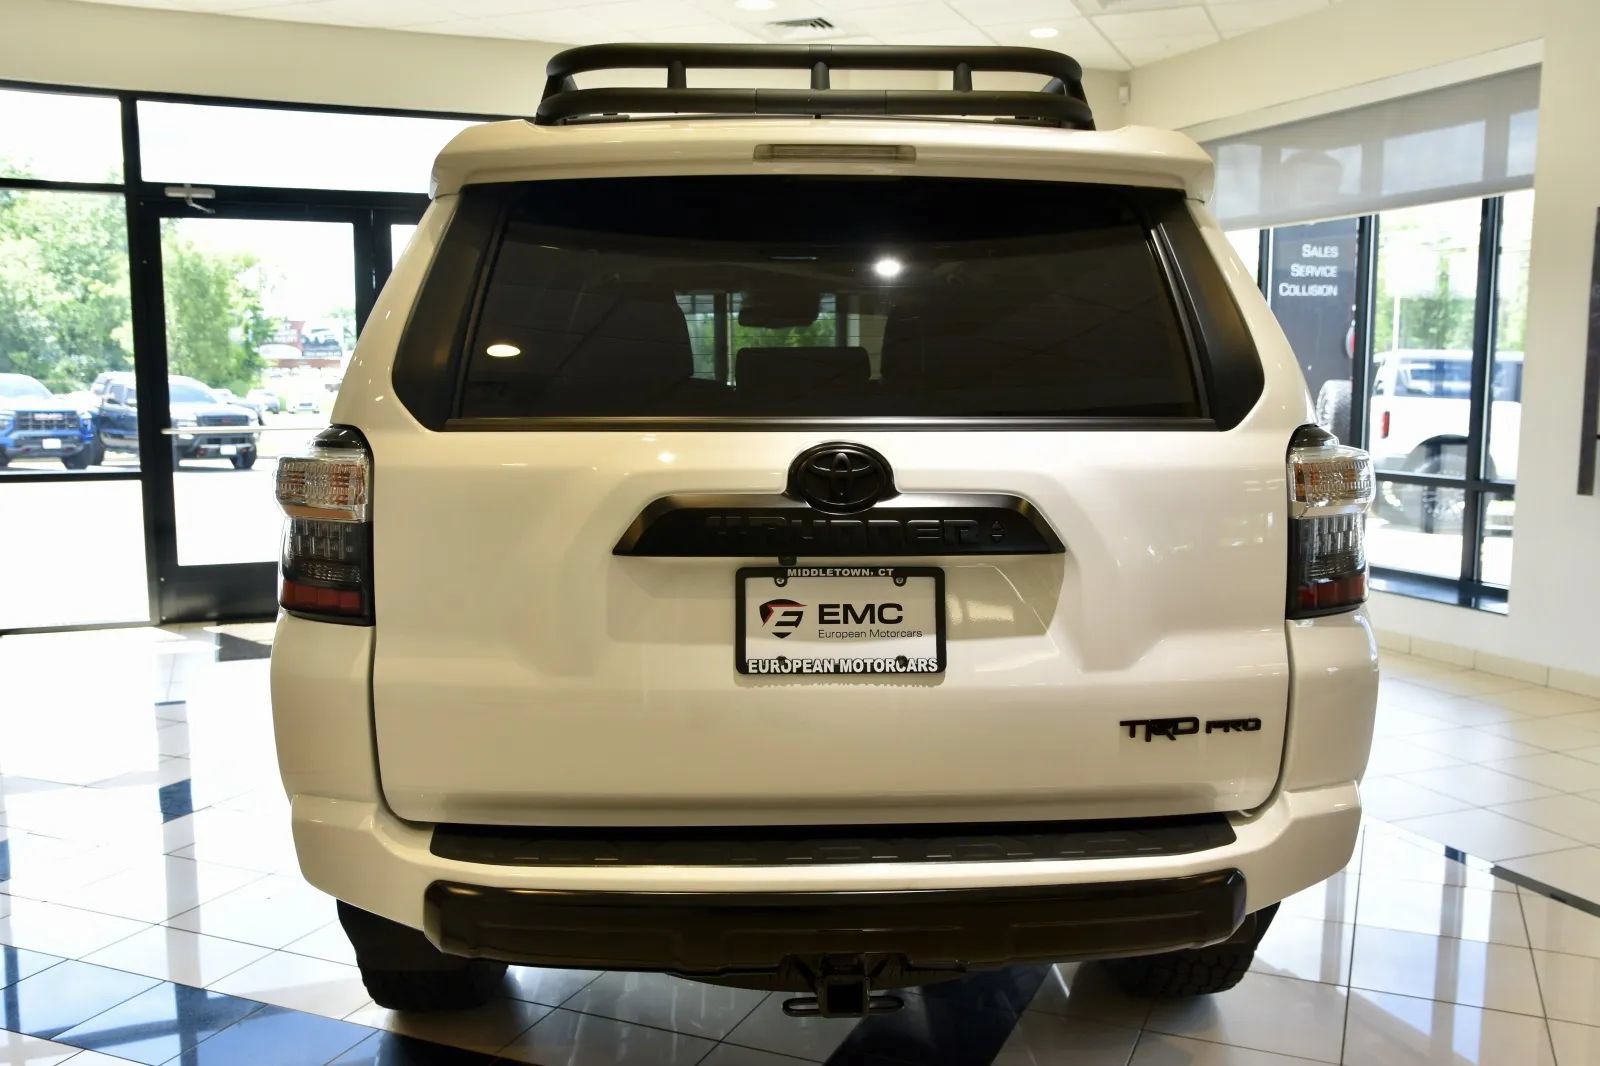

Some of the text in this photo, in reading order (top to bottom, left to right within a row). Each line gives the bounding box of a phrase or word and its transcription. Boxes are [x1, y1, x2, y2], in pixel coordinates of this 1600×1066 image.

[1302, 244, 1339, 258] SALES
[1291, 264, 1337, 277] SERVICE
[1279, 282, 1338, 296] COLLISION
[787, 568, 895, 577] MIDDLETOWN, CT
[818, 603, 903, 625] EMC
[818, 629, 923, 639] European Motorcars
[748, 658, 938, 673] EUROPEAN MOTORCARS
[1120, 716, 1261, 742] TRD PRO
